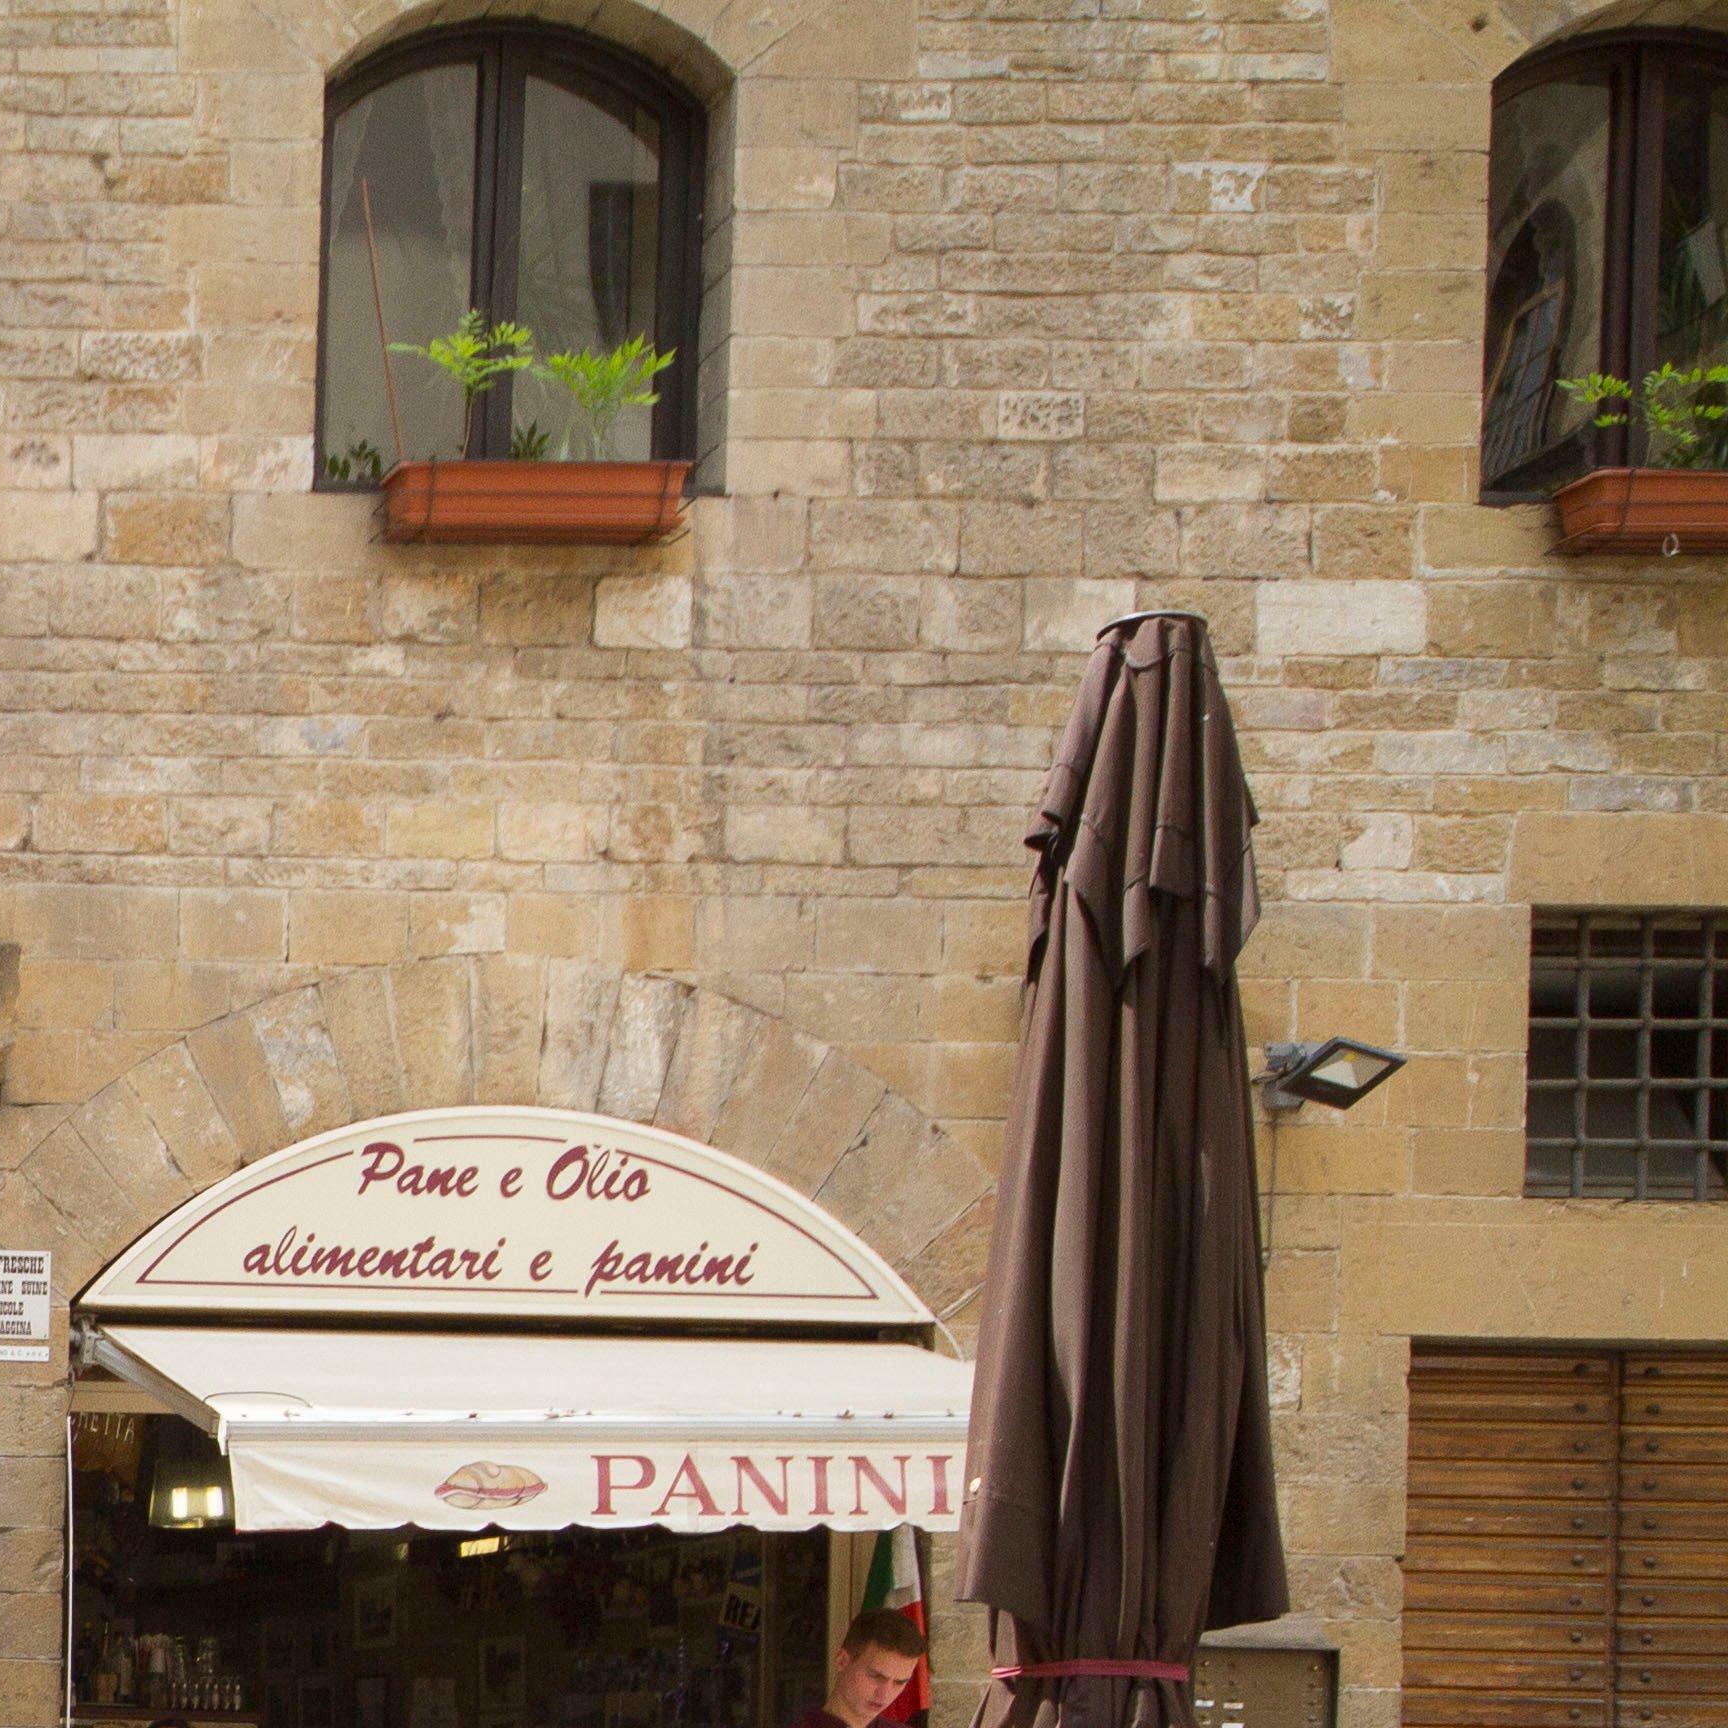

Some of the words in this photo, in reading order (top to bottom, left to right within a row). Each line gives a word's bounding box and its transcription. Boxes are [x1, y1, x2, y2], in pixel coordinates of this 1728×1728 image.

[357, 1142, 480, 1199] Pane
[500, 1166, 524, 1199] e
[545, 1144, 651, 1202] Olio
[21, 1281, 48, 1295] SUINE
[244, 1226, 506, 1280] alimentari
[529, 1250, 553, 1281] e
[585, 1239, 759, 1297] panini
[590, 1451, 955, 1517] PANINI
